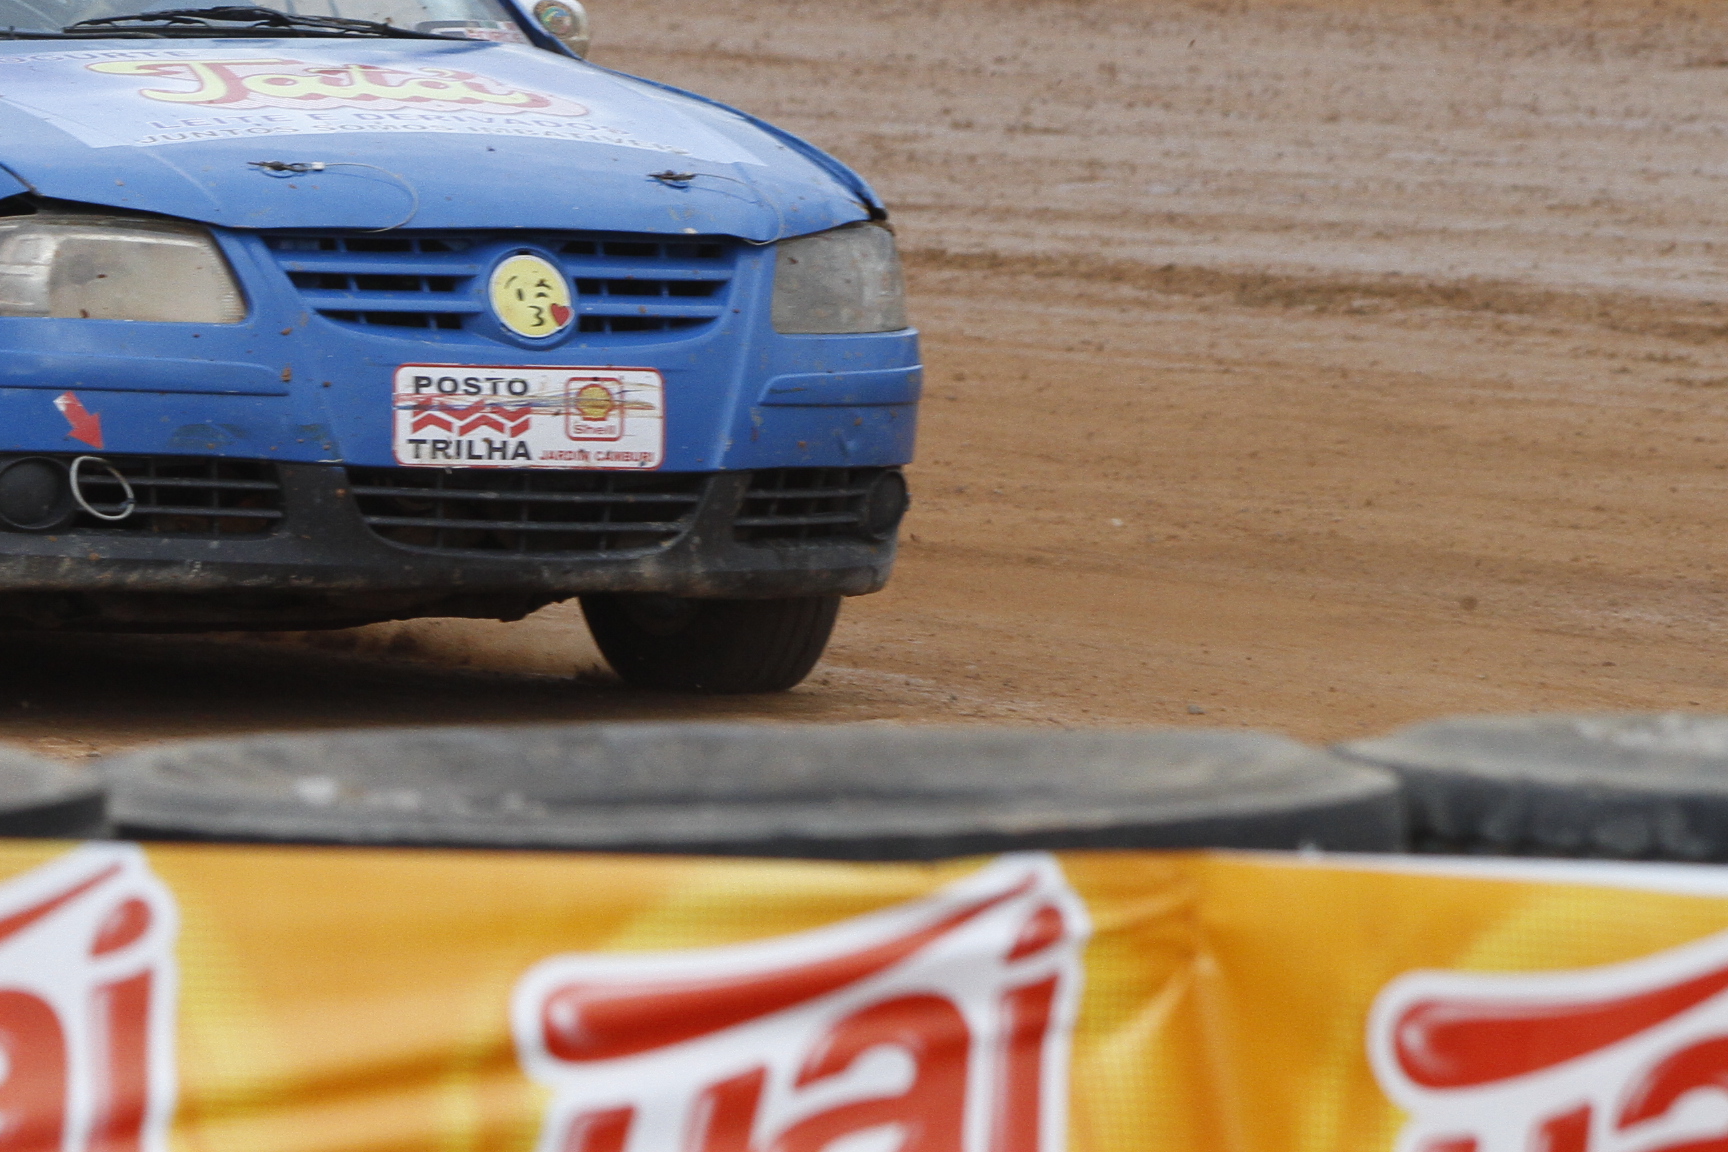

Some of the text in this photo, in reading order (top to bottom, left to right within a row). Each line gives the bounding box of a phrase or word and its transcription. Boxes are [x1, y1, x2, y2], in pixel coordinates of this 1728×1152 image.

[151, 113, 292, 130] LEITE
[307, 113, 339, 121] E
[138, 125, 299, 145] JUNTOS
[313, 123, 453, 132] SOMOS
[412, 375, 529, 396] POSTO
[573, 423, 617, 436] Shell
[406, 439, 655, 463] TRILHA JARDIM CAMBURI
[542, 870, 1065, 1152] ai
